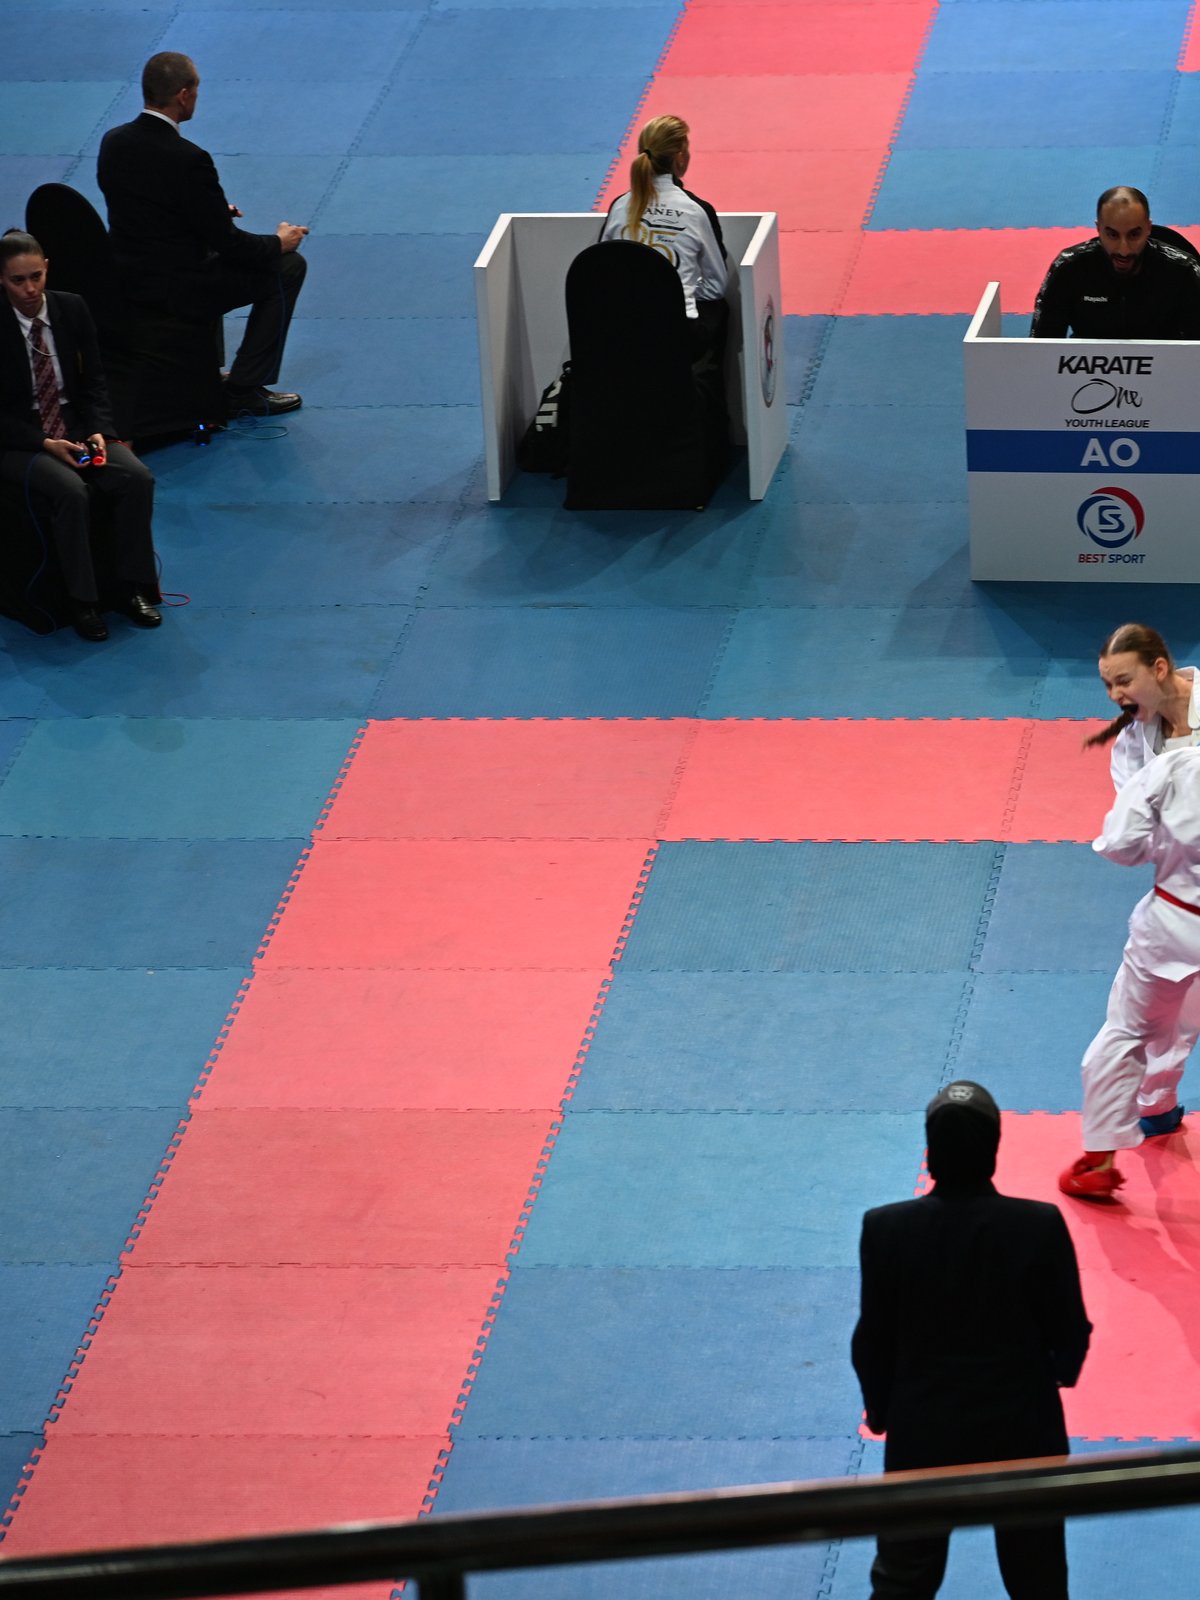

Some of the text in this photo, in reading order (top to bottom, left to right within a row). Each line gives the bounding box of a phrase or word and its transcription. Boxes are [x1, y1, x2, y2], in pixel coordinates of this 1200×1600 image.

[644, 207, 684, 218] ANEV
[1057, 355, 1154, 375] KARATE
[1071, 378, 1143, 414] One
[1065, 419, 1150, 428] YOUTH LEAGUE
[1080, 437, 1141, 467] AO
[1078, 553, 1146, 564] BEST SPORT
